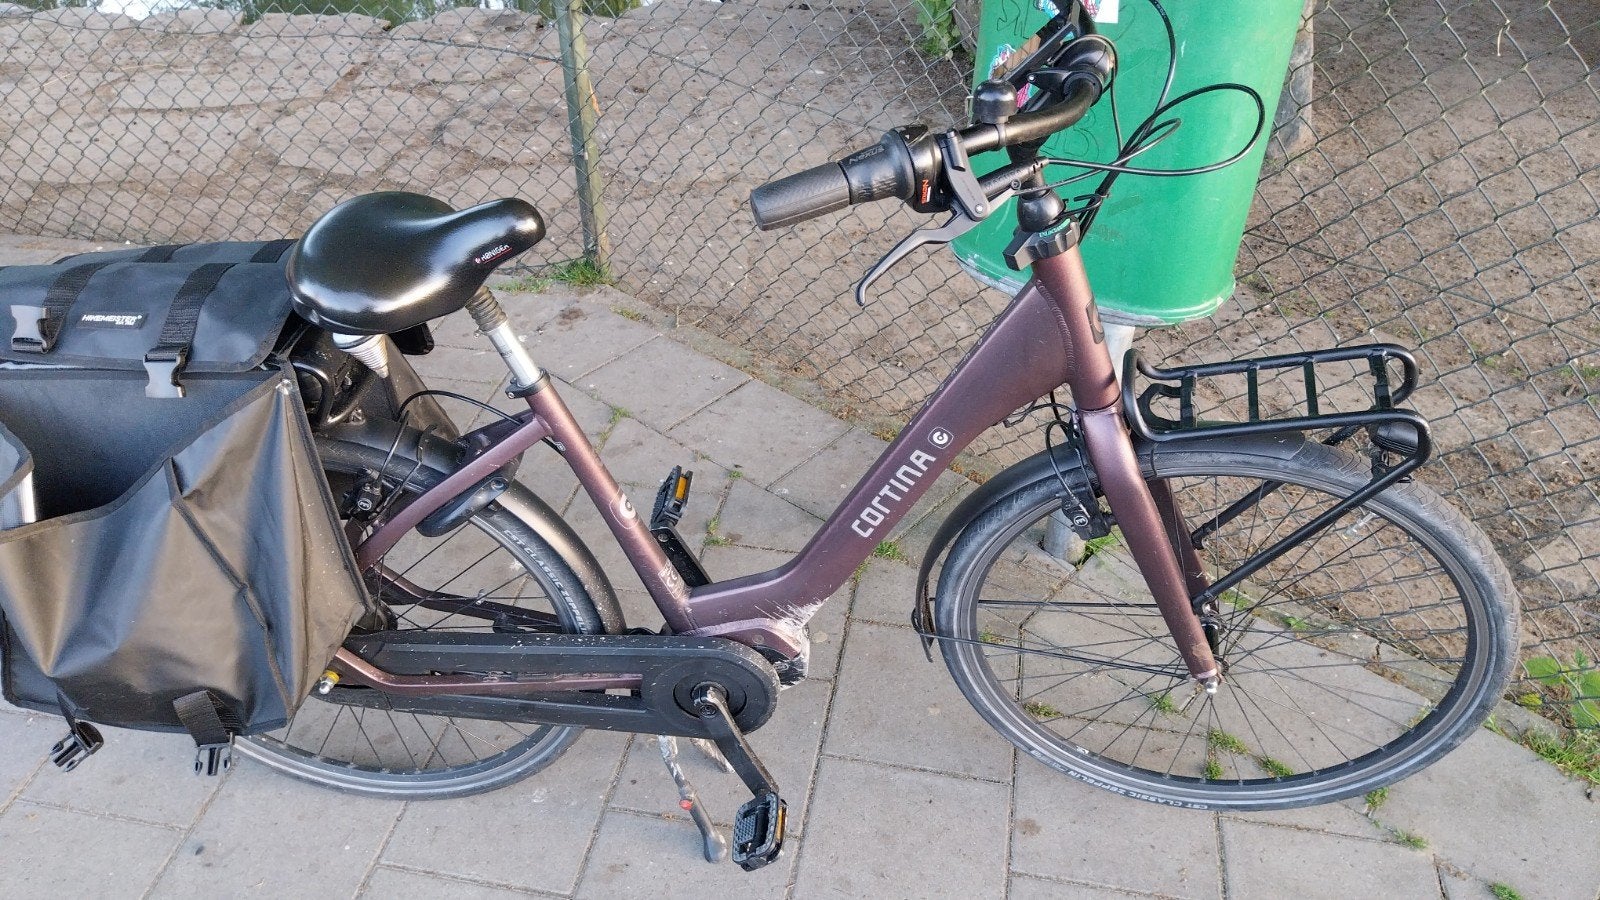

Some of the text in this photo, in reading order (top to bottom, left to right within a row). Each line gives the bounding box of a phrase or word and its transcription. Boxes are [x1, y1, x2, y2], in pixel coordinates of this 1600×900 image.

[525, 545, 564, 592] CLASSIC
[560, 590, 589, 634] ZEPPELI
[1068, 770, 1127, 795] ZEPPELIN
[1128, 791, 1183, 807] CLASSIC
